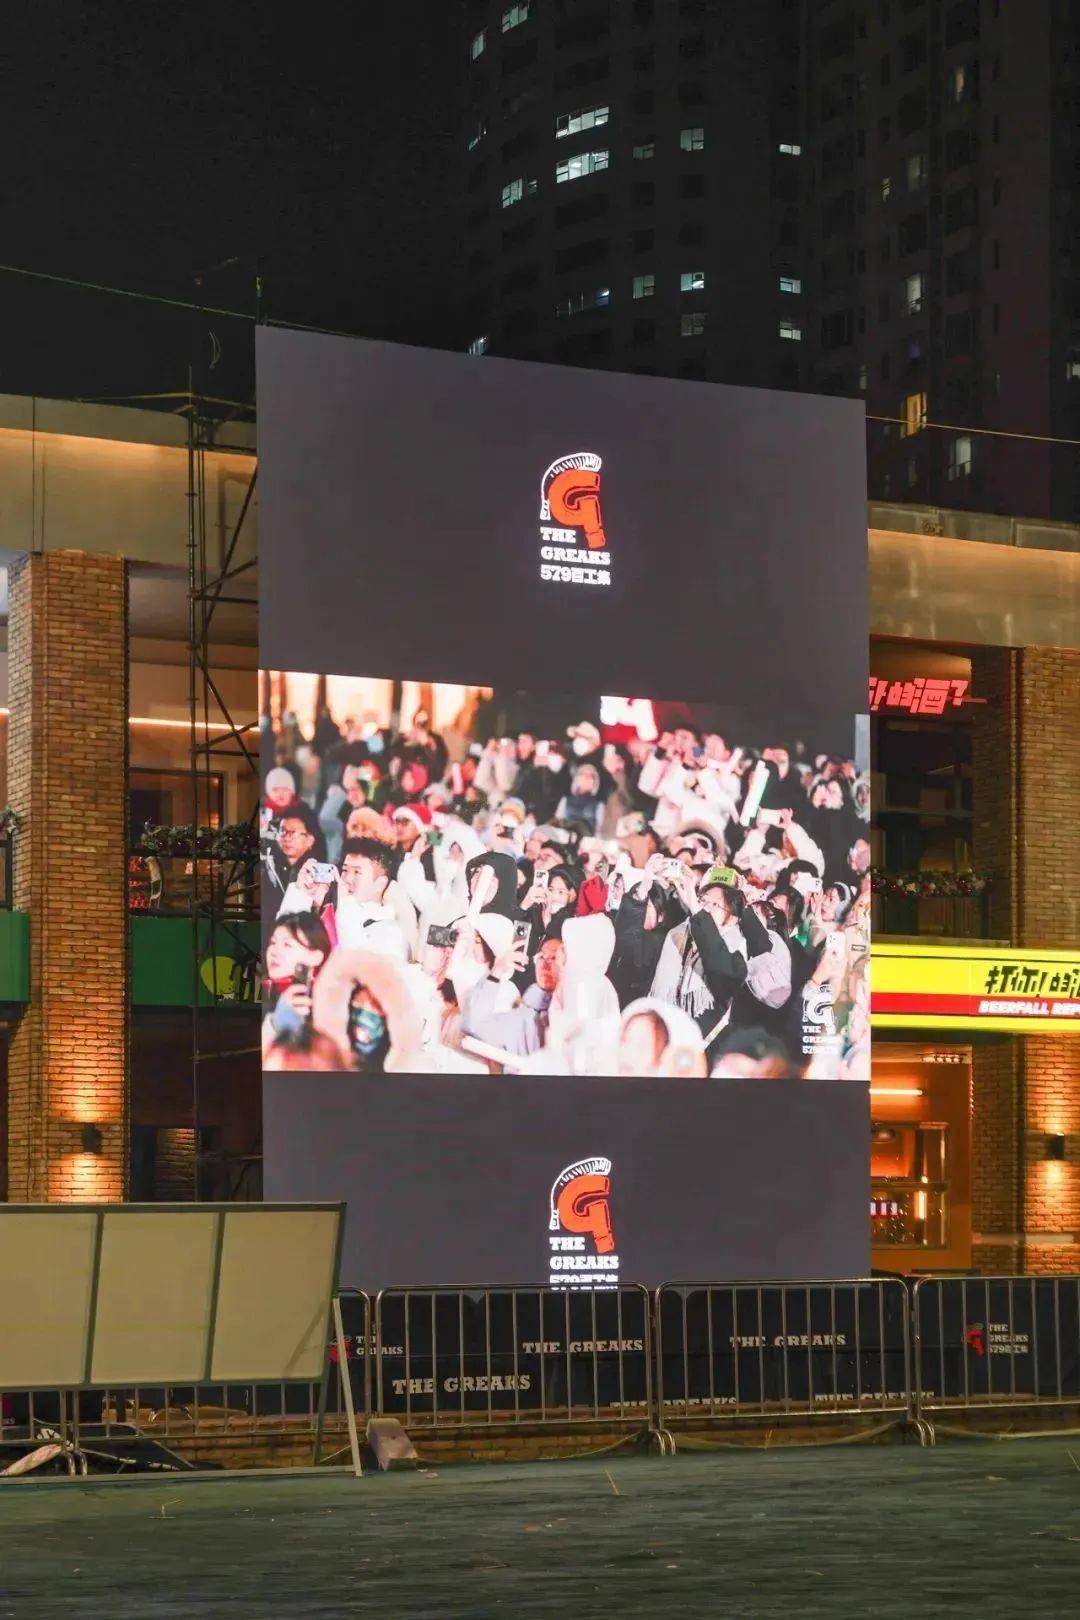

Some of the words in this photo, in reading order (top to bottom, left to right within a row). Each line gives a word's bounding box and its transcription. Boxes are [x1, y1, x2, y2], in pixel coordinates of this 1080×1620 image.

[540, 527, 576, 543] THE
[541, 546, 610, 565] GREAKS
[802, 1025, 822, 1033] THE
[549, 1237, 585, 1250] THE
[549, 1255, 619, 1270] GREAKS
[522, 1342, 560, 1353] THE
[569, 1340, 643, 1353] GREAKS
[392, 1378, 434, 1395] THE
[443, 1375, 531, 1393] GREAKS
